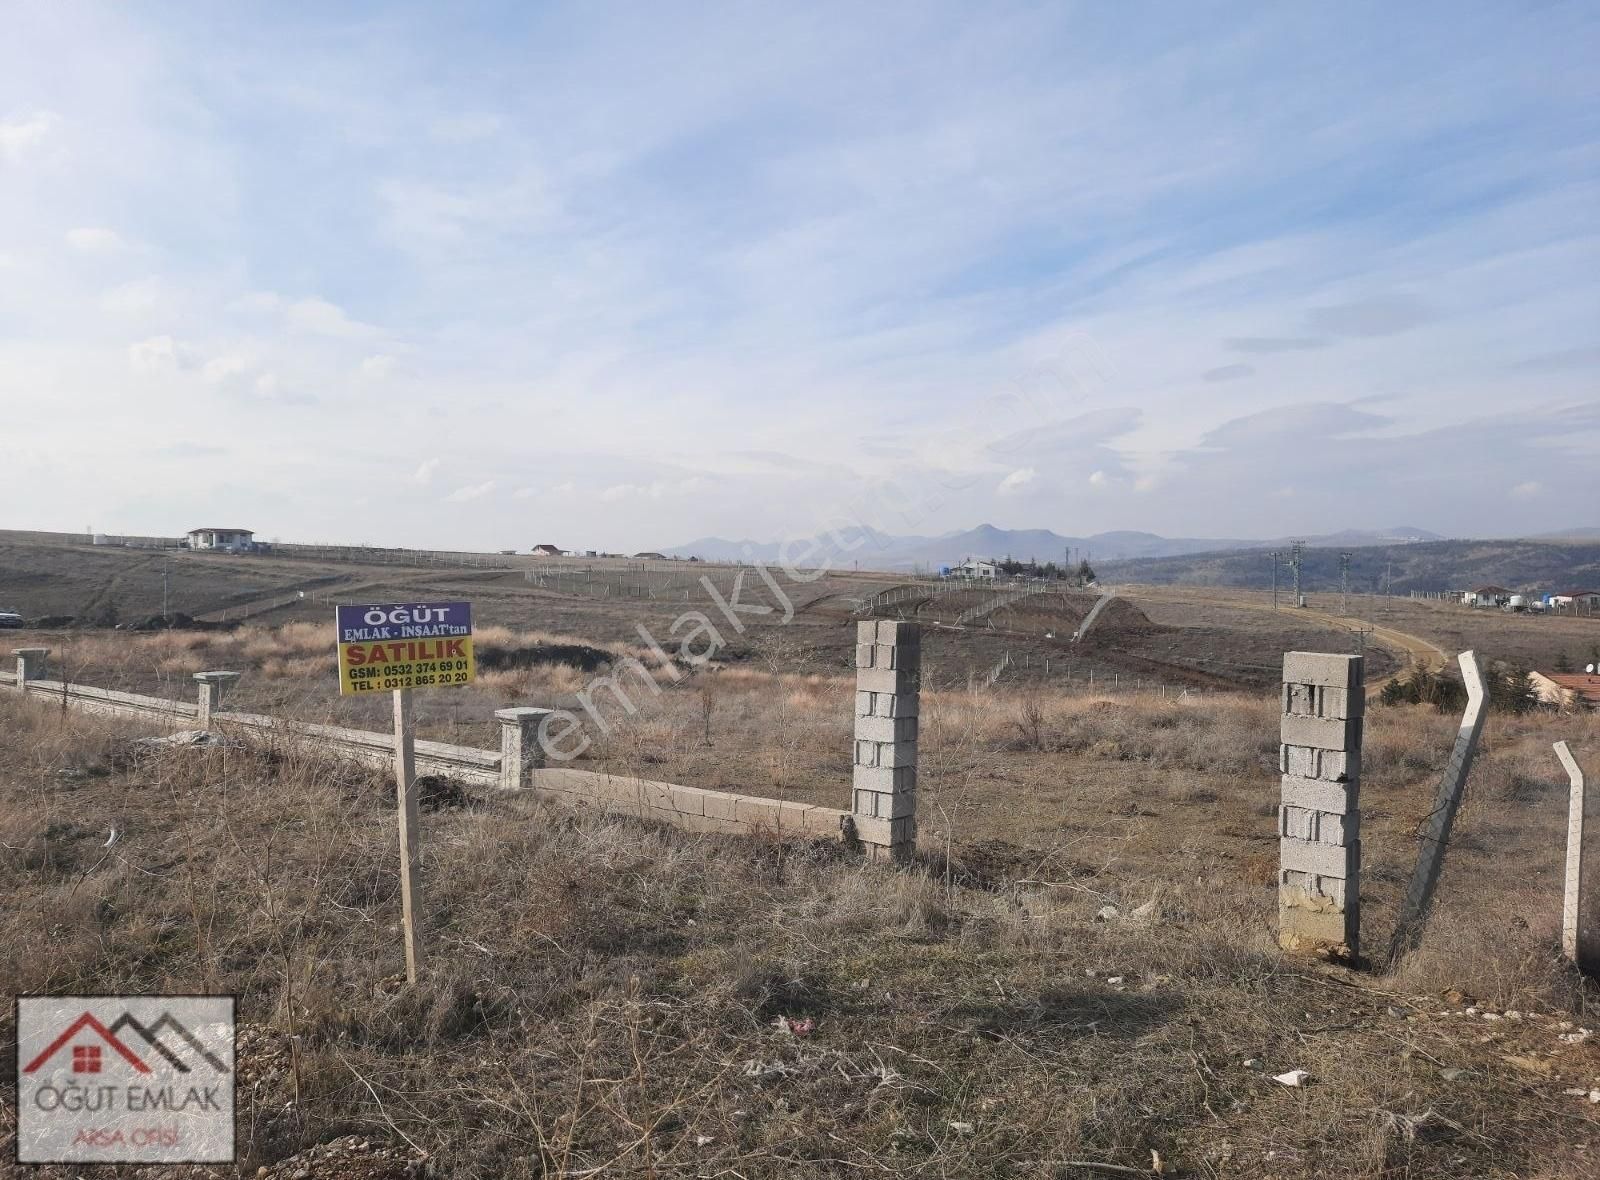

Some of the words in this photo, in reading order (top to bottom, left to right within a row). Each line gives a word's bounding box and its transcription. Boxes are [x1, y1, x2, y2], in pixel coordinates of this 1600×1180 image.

[363, 605, 450, 626] ÖĞÜT
[344, 628, 391, 641] EMLAK
[346, 639, 466, 666] SATILIK
[349, 667, 381, 680] GSM:
[384, 664, 413, 677] 0532
[416, 662, 437, 674] 374
[439, 661, 453, 672] 69
[456, 660, 468, 670] 01
[384, 677, 412, 689] 0312
[415, 674, 436, 686] 865
[438, 673, 452, 684] 20
[455, 672, 468, 682] 20
